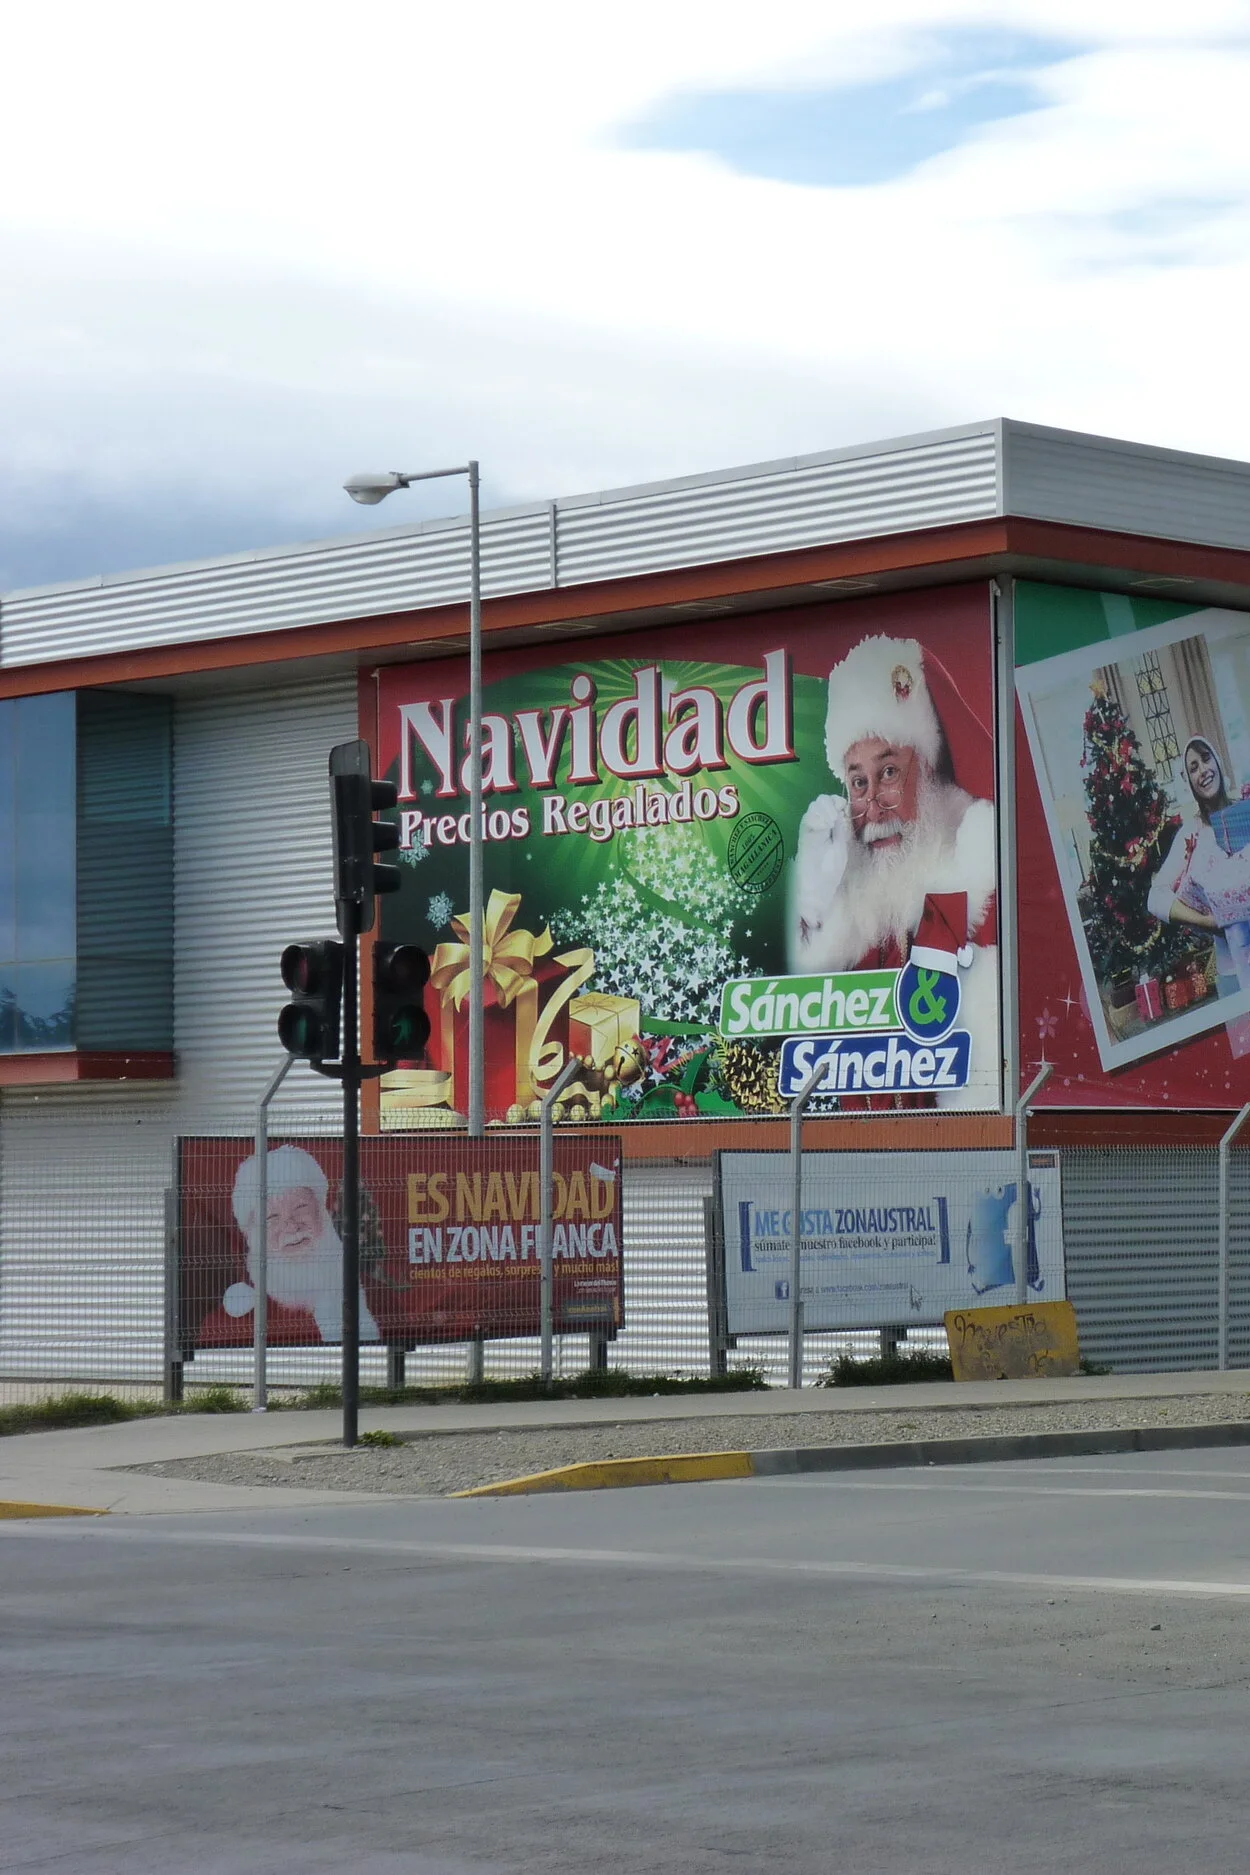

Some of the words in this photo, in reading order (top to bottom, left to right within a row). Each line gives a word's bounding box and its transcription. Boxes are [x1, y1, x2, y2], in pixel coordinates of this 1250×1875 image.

[398, 647, 797, 799] Navidad
[400, 801, 530, 850] Precios
[542, 784, 740, 842] Regalados
[727, 978, 892, 1033] Sánchez
[908, 968, 947, 1025] &
[790, 1038, 958, 1092] Sánchez
[407, 1172, 449, 1223] ES
[455, 1170, 616, 1222] NAVIDAD
[755, 1210, 779, 1236] ME
[835, 1206, 936, 1233] ZONAUSTRAL
[408, 1227, 443, 1264] EN
[446, 1225, 517, 1262] ZONA
[754, 1238, 791, 1252] súmate
[800, 1238, 837, 1251] nuestro
[839, 1235, 882, 1249] facebook
[882, 1237, 890, 1249] y
[891, 1234, 937, 1249] participa!
[409, 1266, 446, 1280] cientos
[449, 1265, 462, 1279] de
[464, 1264, 503, 1281] regalos,
[505, 1264, 545, 1279] sorpres
[553, 1263, 560, 1275] y
[562, 1261, 593, 1274] mucho
